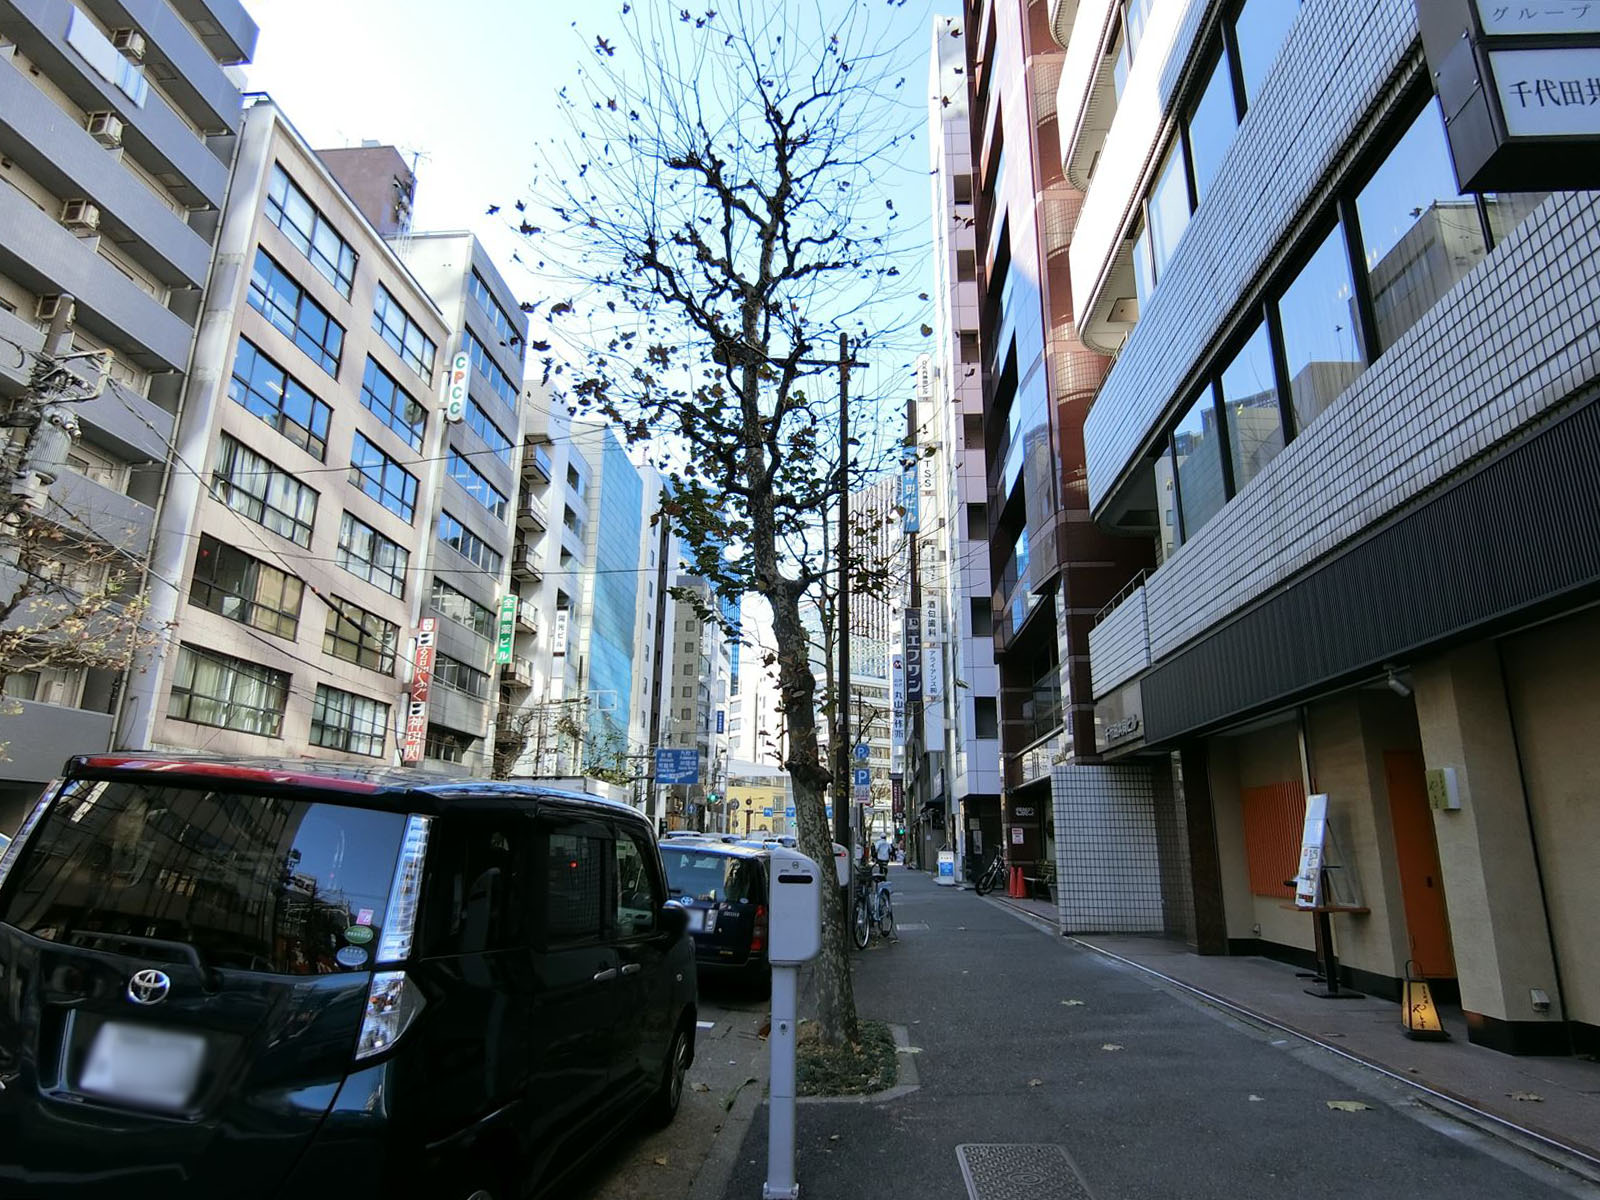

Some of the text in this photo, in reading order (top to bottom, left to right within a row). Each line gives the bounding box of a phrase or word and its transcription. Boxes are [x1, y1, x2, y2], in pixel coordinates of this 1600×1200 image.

[450, 356, 466, 415] CPCC
[924, 460, 932, 488] TSS
[907, 635, 921, 693] エフワン
[858, 770, 868, 784] P
